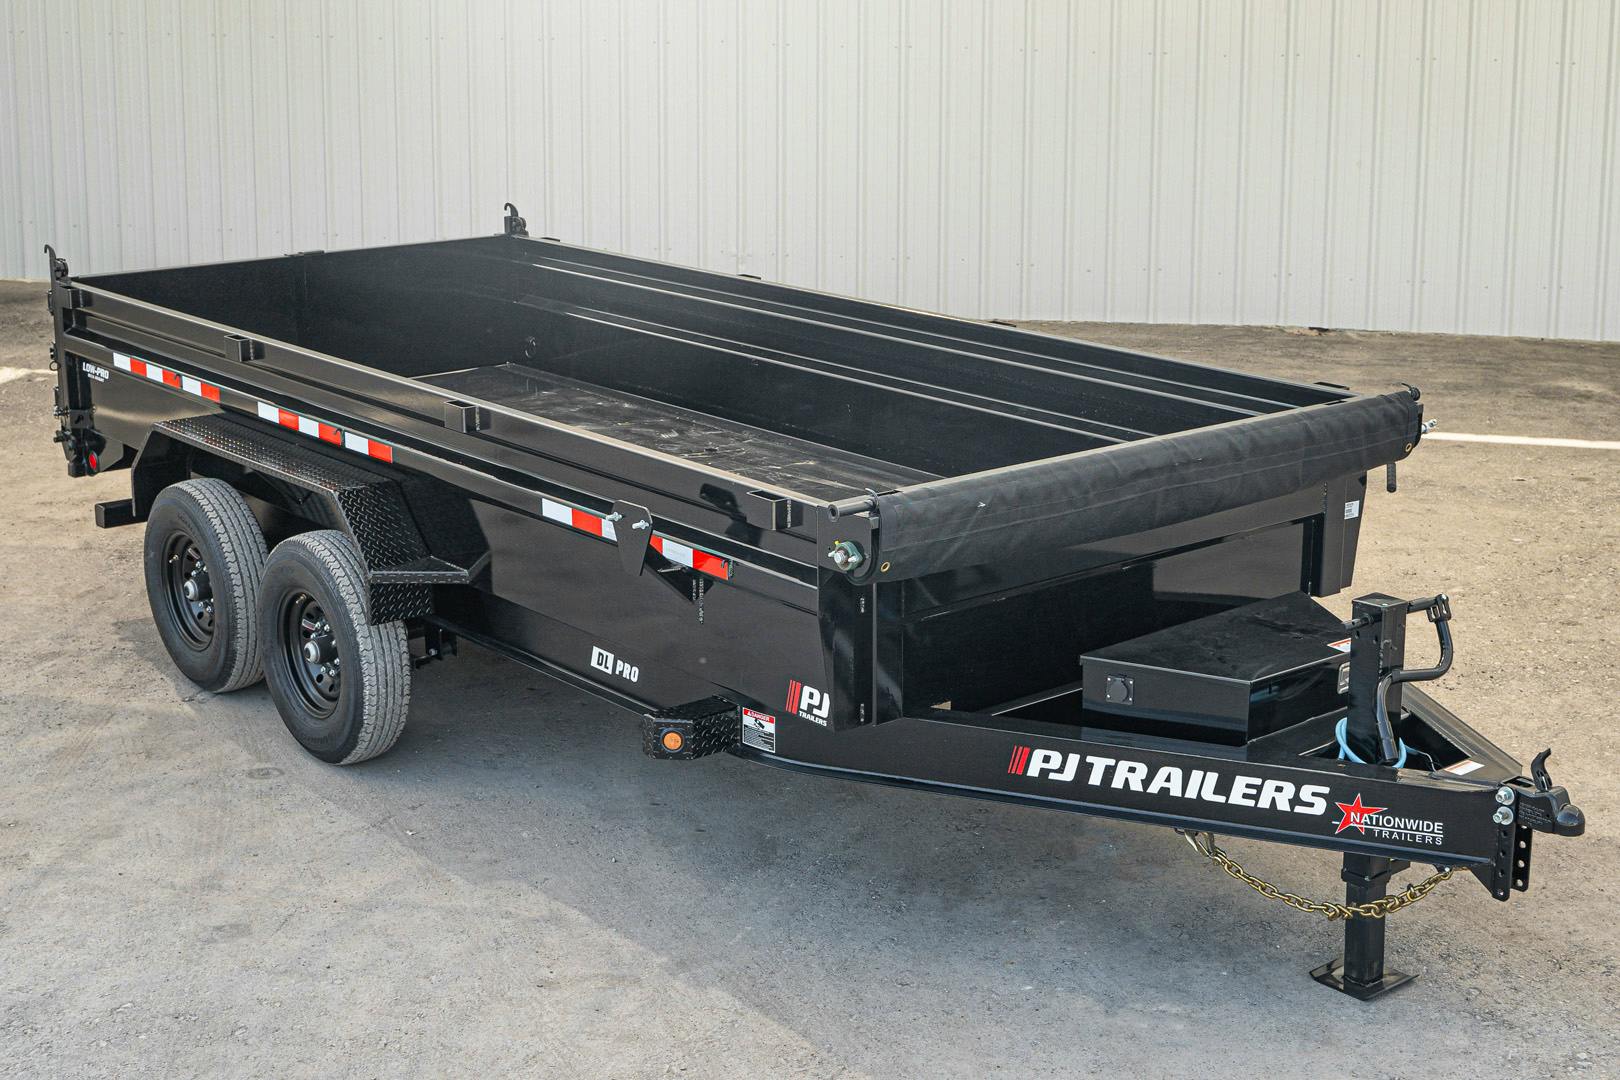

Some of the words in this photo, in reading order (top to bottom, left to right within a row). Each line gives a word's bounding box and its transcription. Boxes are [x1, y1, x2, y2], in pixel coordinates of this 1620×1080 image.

[83, 362, 109, 379] LOW-PRO
[597, 651, 609, 670] DL
[615, 659, 639, 682] PRO
[800, 685, 830, 718] PJ
[799, 710, 827, 727] TRAILERS
[1026, 748, 1080, 782] PJ
[1085, 755, 1330, 816] TRAILERS
[1350, 811, 1444, 833] NATIONWIDE
[1373, 829, 1442, 845] TRAILERS
